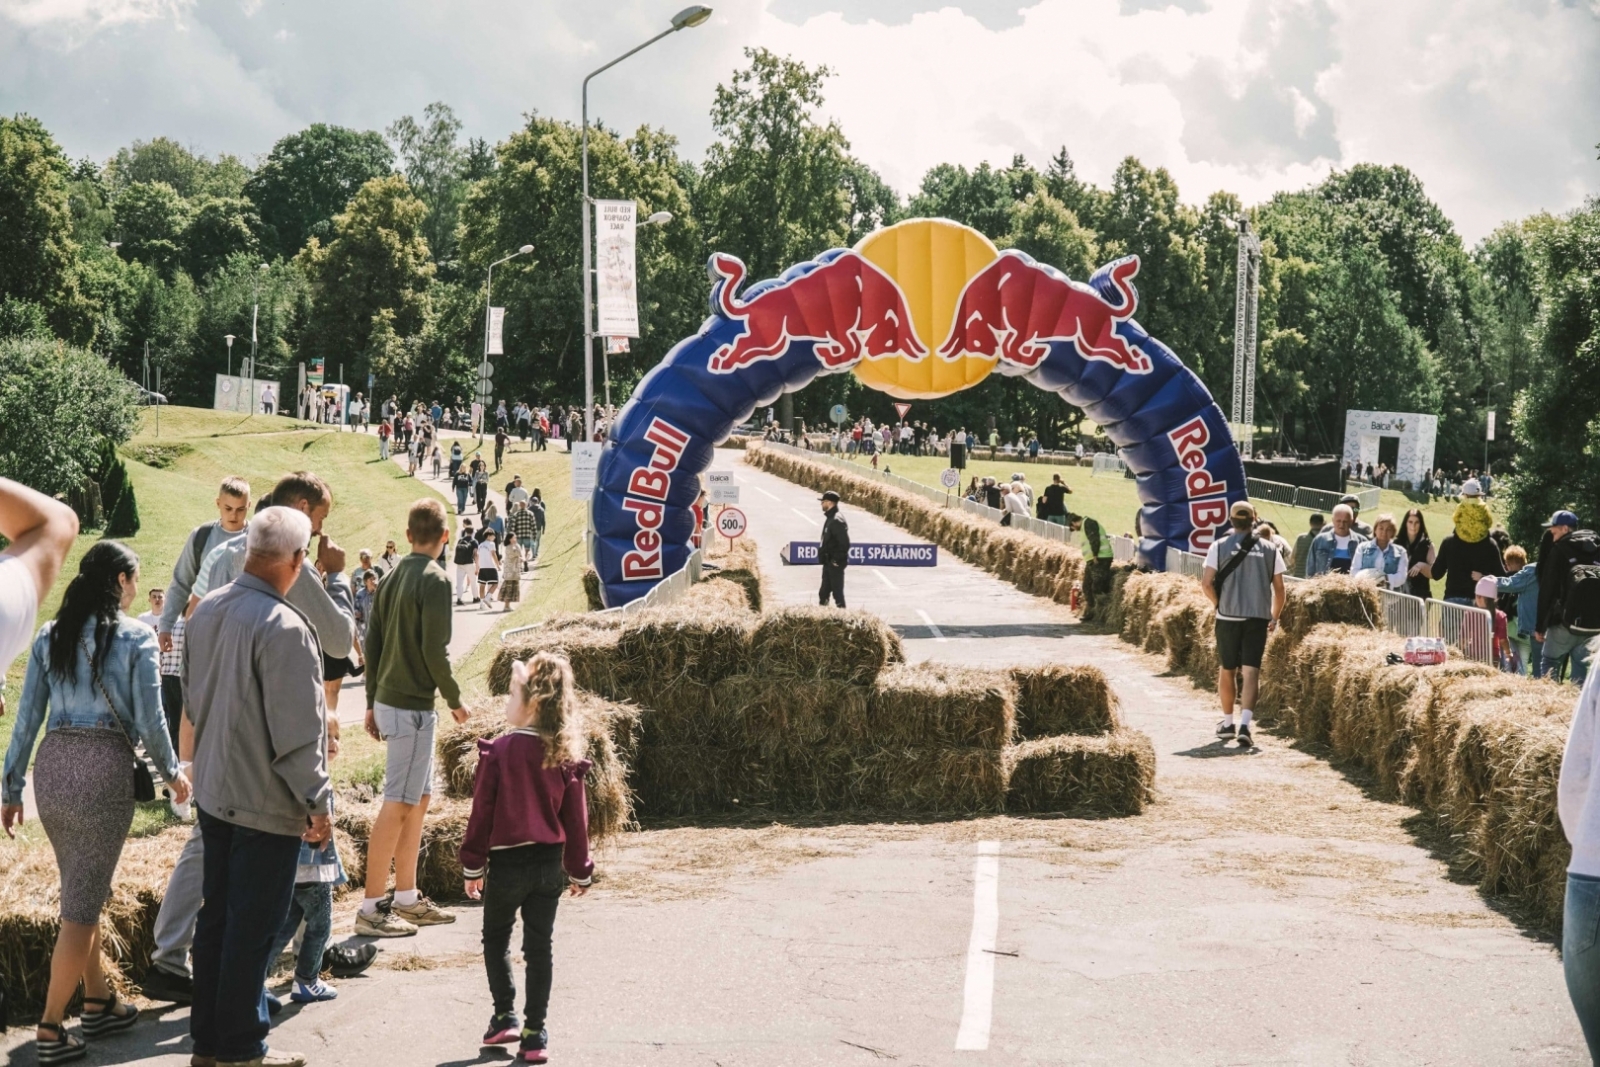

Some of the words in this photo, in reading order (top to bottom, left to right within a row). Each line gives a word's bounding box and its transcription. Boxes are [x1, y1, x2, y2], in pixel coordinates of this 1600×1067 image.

[628, 417, 691, 500] Bull
[1168, 416, 1227, 498] Red
[622, 498, 665, 580] Red
[722, 519, 738, 530] 500
[797, 546, 818, 559] RED
[1189, 498, 1228, 556] Bu
